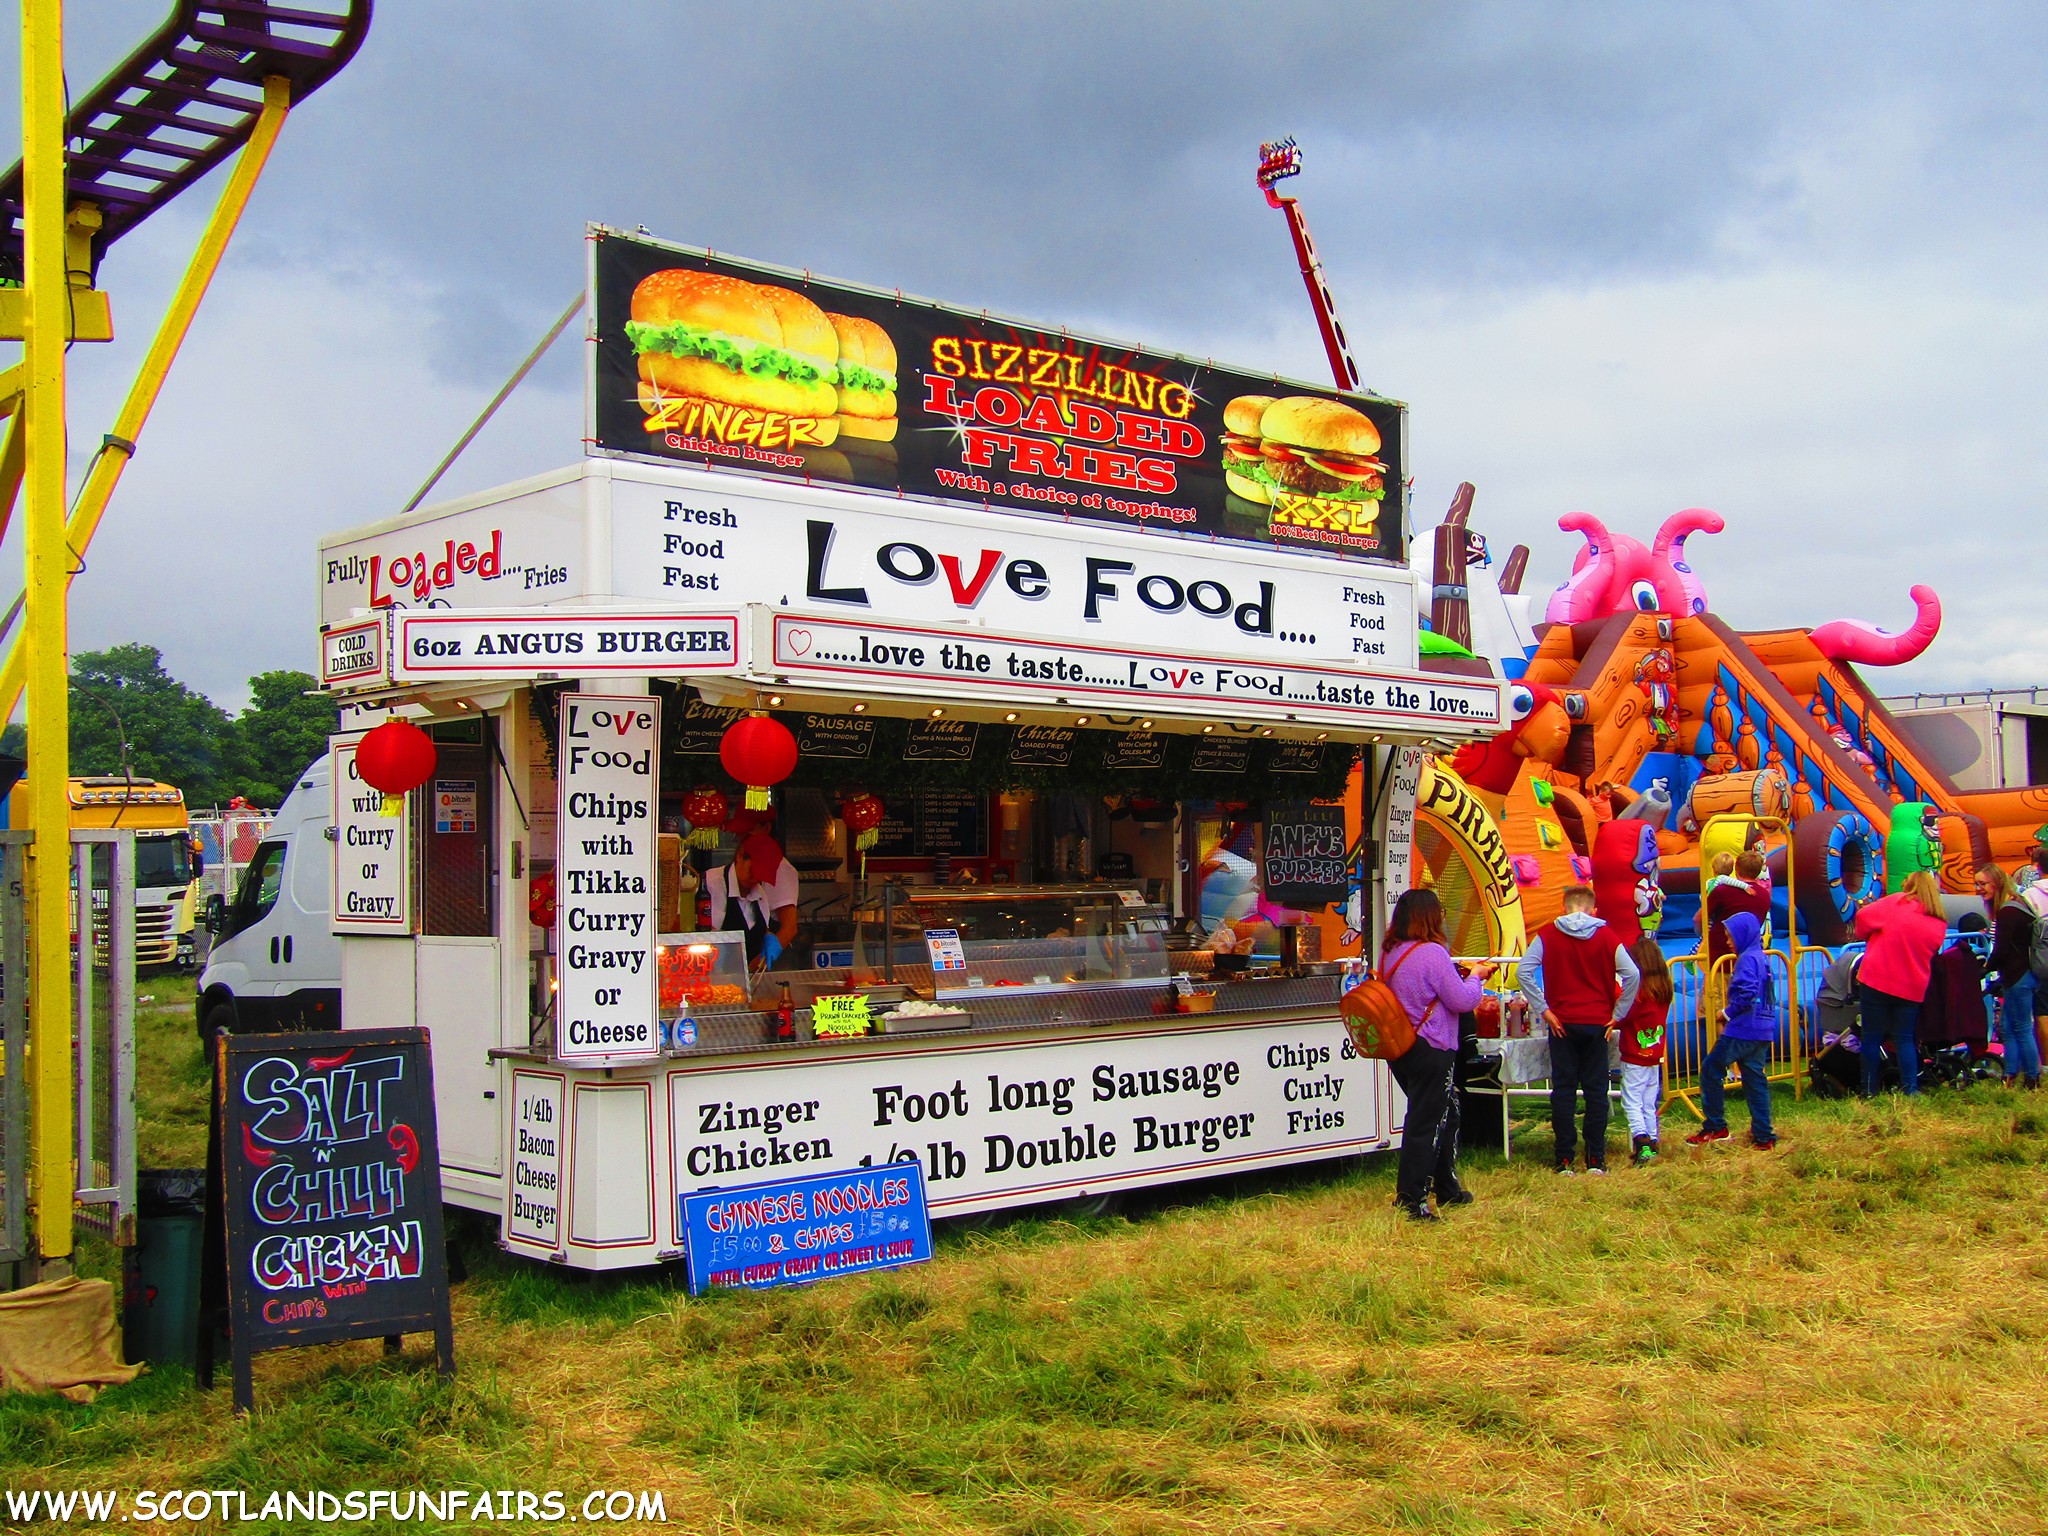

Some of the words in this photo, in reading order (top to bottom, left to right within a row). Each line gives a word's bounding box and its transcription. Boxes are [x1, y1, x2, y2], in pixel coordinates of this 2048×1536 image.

[931, 336, 1196, 419] SIZZLING
[643, 396, 826, 450] ZINGER
[923, 374, 1206, 459] LOADED
[665, 434, 740, 460] Chicken
[744, 445, 805, 468] Burger
[961, 429, 1178, 495] FRIES
[935, 468, 990, 495] With
[994, 484, 1006, 496] a
[1010, 480, 1074, 506] choice
[1081, 491, 1102, 510] of
[1104, 495, 1198, 523] toppings!
[663, 500, 739, 529] Fresh
[1274, 494, 1373, 536] XXL
[663, 533, 726, 560] Food
[1340, 533, 1380, 550] Burger
[327, 555, 369, 587] Fully
[523, 564, 569, 591] Fries
[662, 565, 721, 592] Fast
[806, 519, 1052, 609] Love
[1342, 586, 1386, 607] Fresh
[1349, 612, 1386, 632] Food
[338, 636, 367, 653] COLD
[412, 636, 462, 658] 6oz
[474, 632, 584, 656] ANGUS
[597, 630, 731, 653] BURGER
[1352, 637, 1386, 655] Fast
[331, 652, 375, 674] DRINKS
[940, 643, 991, 673] the
[1129, 661, 1205, 690] Love
[1386, 685, 1420, 709] the
[569, 705, 653, 739] Love
[684, 698, 750, 729] Burge
[923, 718, 965, 735] Tikka
[815, 732, 833, 740] WITH
[834, 733, 860, 741] ONIONS
[1017, 724, 1074, 742] Chicken
[1046, 742, 1065, 750] FRIES
[570, 746, 651, 775] Food
[1392, 775, 1416, 796] Food
[568, 792, 648, 826] Chips
[1390, 805, 1412, 828] Zinger
[346, 824, 394, 851] Curry
[581, 834, 634, 856] with
[1266, 824, 1346, 859] ANGUS
[1388, 829, 1410, 844] Chicken
[1422, 773, 1517, 899] PIRATA
[362, 863, 379, 879] or
[1266, 858, 1347, 887] BURGER
[1388, 850, 1408, 868] Burger
[10, 881, 21, 897] 5
[567, 869, 646, 894] Tikka
[1394, 873, 1402, 884] on
[346, 891, 395, 919] Gravy
[568, 906, 646, 938] Curry
[568, 944, 646, 974] Gravy
[594, 986, 622, 1006] or
[831, 1001, 855, 1012] FREE
[820, 1012, 840, 1021] PRAWN
[569, 1019, 648, 1045] Cheese
[1266, 1042, 1331, 1071] Chips
[244, 1056, 404, 1145] SALT
[872, 1079, 969, 1128] Foot
[987, 1075, 1076, 1116] long
[1091, 1058, 1240, 1103] Sausage
[1283, 1073, 1345, 1102] Curly
[523, 1094, 553, 1124] 1/4lb
[699, 1099, 821, 1135] Zinger
[1286, 1108, 1345, 1135] Fries
[518, 1128, 556, 1157] Bacon
[686, 1136, 833, 1177] Chicken
[984, 1123, 1117, 1174] Double
[1132, 1110, 1255, 1153] Burger
[516, 1160, 557, 1191] Cheese
[253, 1161, 406, 1225] CHILLI
[705, 1190, 807, 1235] CHINESE
[813, 1177, 911, 1219] NOODLES
[513, 1193, 557, 1230] Burger
[767, 1232, 790, 1256] &
[794, 1222, 854, 1251] CHIPS
[709, 1268, 741, 1288] WITH
[743, 1261, 781, 1284] CURRY
[783, 1253, 822, 1279] GRAVY
[823, 1252, 840, 1271] OR
[840, 1245, 876, 1269] SWEET
[886, 1238, 914, 1259] SOUR
